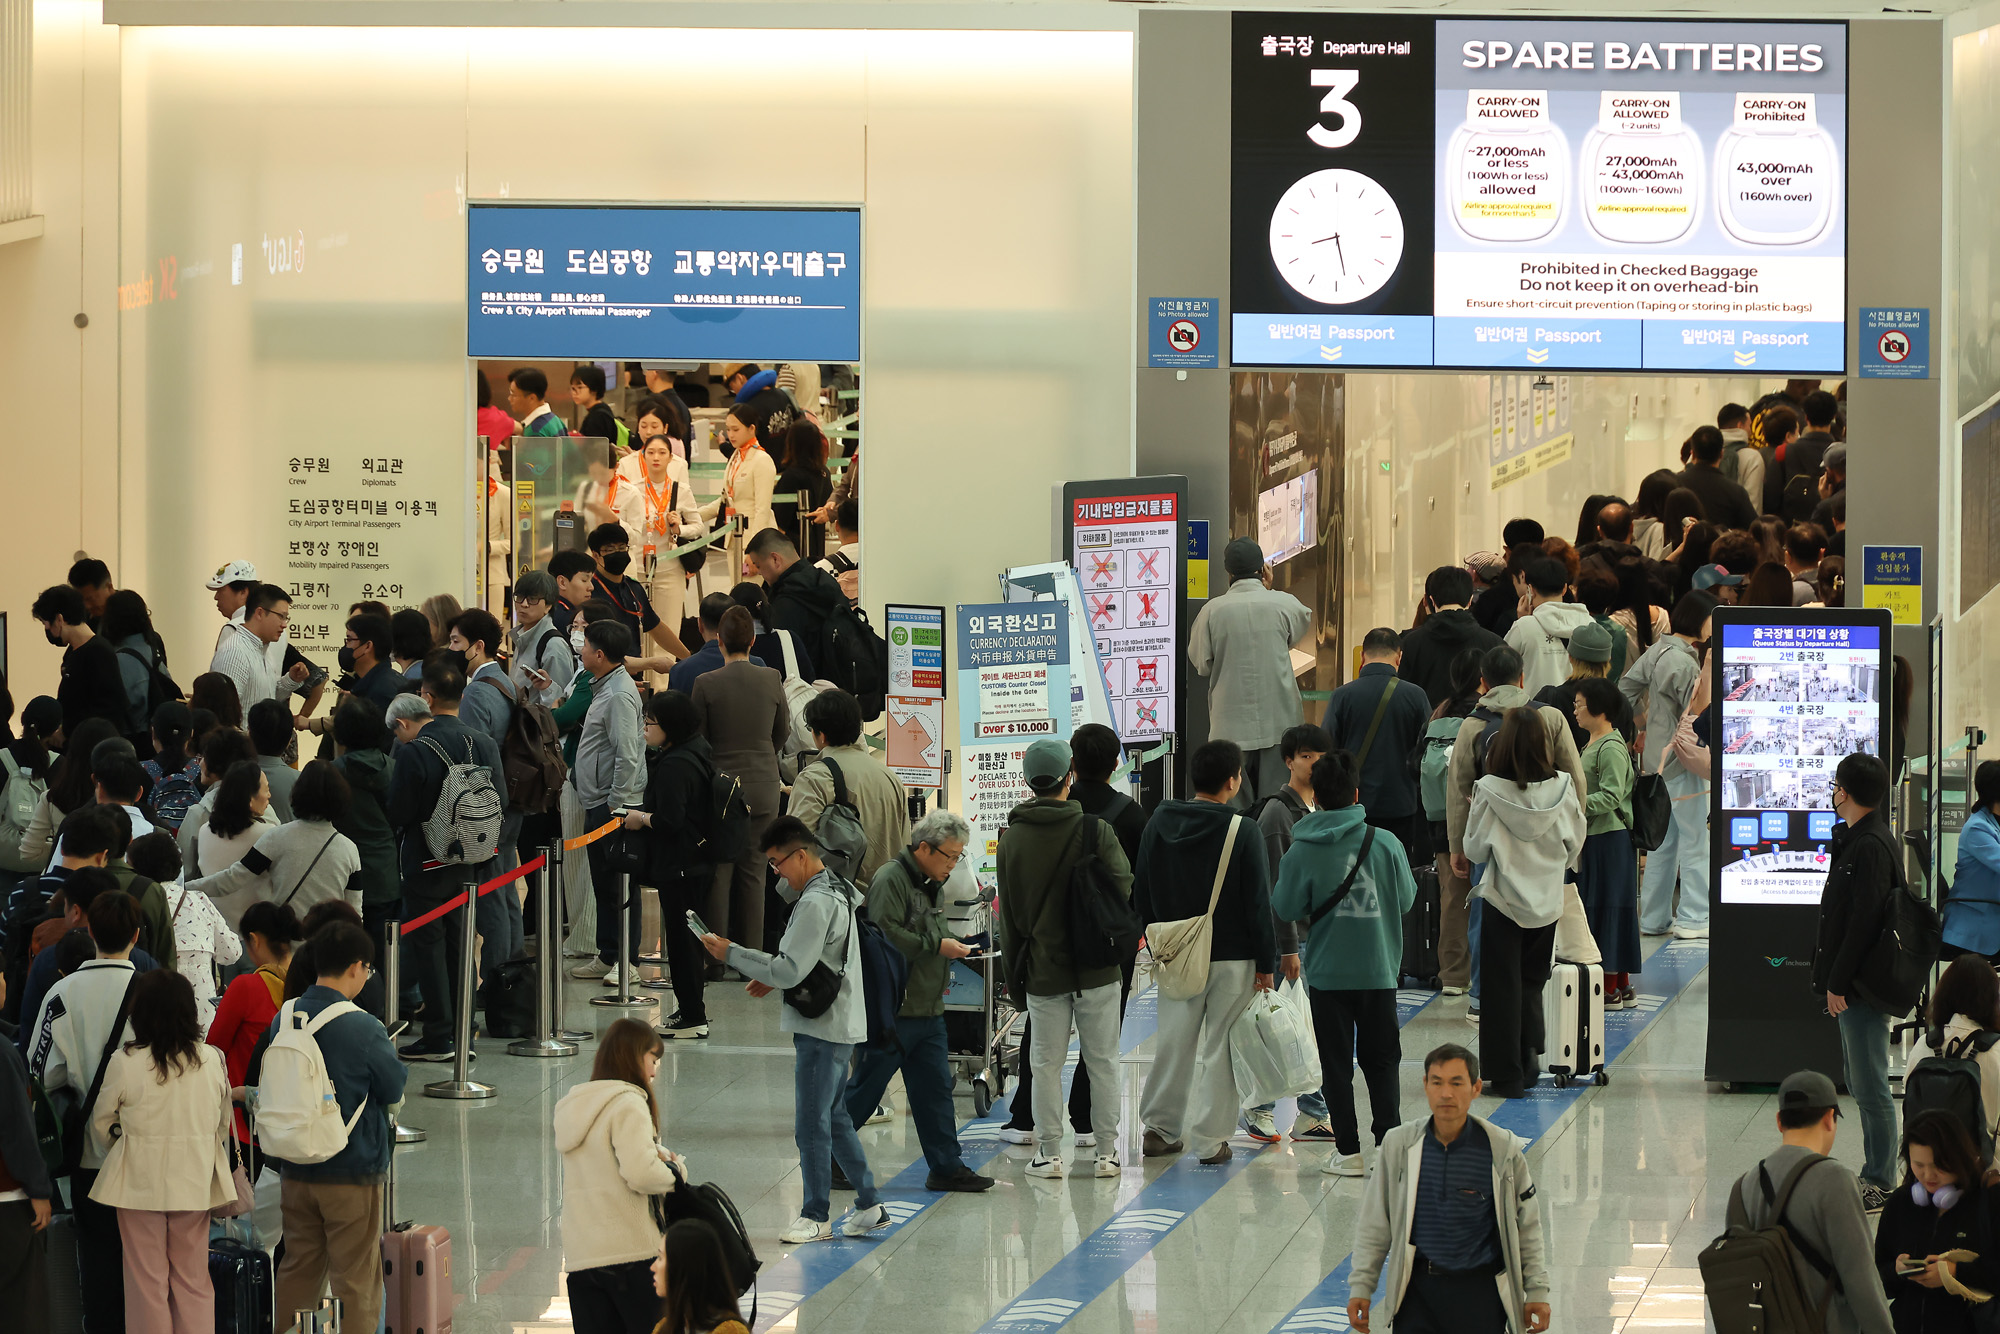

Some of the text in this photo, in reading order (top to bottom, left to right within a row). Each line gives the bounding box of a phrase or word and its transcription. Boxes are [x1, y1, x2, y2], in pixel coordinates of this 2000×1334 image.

[1261, 35, 1314, 56] 출국장
[1324, 41, 1410, 57] Departure Hall
[1462, 40, 1824, 72] SPARE BATTERIES
[1477, 97, 1540, 106] CARRY-ON
[1612, 99, 1670, 108] CARRY-ON
[1744, 100, 1806, 110] CARRY-ON
[1306, 68, 1362, 148] 3
[1478, 109, 1538, 118] ALLOWED
[1614, 110, 1669, 118] ALLOWED
[1745, 112, 1804, 121] Prohibited
[1468, 146, 1546, 158] ~27,000mAh
[1504, 158, 1528, 168] less
[1606, 156, 1676, 168] 27,000mAh
[1737, 163, 1813, 174] 43,000mAh
[1468, 172, 1508, 180] (100Wh
[1525, 172, 1548, 180] less)
[1612, 170, 1684, 181] 43,000mAh
[1761, 177, 1792, 185] over
[1480, 184, 1536, 194] allowed
[1600, 186, 1682, 194] (100Wh~160Wh)
[1740, 192, 1812, 202] (160Wh over)
[482, 248, 846, 277] 승무원 도심공항 교통약자우대출구
[1521, 263, 1758, 279] Prohibited in Checked Baggage
[1520, 278, 1758, 294] Do not keep it on overhead-bin
[1467, 299, 1504, 308] Ensure
[1506, 300, 1572, 308] short-circuit
[1576, 301, 1634, 310] prevention
[1636, 302, 1676, 312] (Taping
[1692, 302, 1730, 312] storing
[1733, 302, 1742, 311] in
[1746, 302, 1780, 312] plastic
[1783, 303, 1812, 313] bags)
[482, 306, 652, 319] Crew & City Airport Terminal Passenger
[1268, 324, 1395, 342] 일반여권 Passport
[1474, 326, 1602, 344] 일반여권 Passport
[1682, 329, 1809, 347] 일반여권 Passport
[289, 458, 330, 472] 승무원
[362, 458, 404, 474] 외교관
[362, 478, 396, 487] Diplomats
[289, 500, 438, 516] 도심공항터미널 이용객
[1078, 500, 1172, 519] 기내반입금지물품
[288, 520, 302, 528] City
[304, 520, 328, 528] Airport
[362, 521, 401, 530] Passengers
[289, 540, 378, 557] 보행상 장애인
[288, 562, 390, 572] Mobility Impaired Passengers
[1876, 564, 1910, 573] 진입불가
[289, 582, 330, 598] 고령자
[362, 583, 404, 598] 유소아
[969, 613, 1056, 634] 외국환신고
[289, 624, 330, 639] 임신부
[1753, 628, 1849, 640] 출국장별 대기열 상황
[970, 635, 1057, 650] CURRENCY DECLARATION
[971, 649, 1057, 664] 外币申报 外貨申告
[1780, 652, 1824, 662] 2번 출국장
[1002, 671, 1031, 680] 세관신고대
[1778, 705, 1824, 715] 4번 출국장
[983, 722, 1048, 734] over $ 10,000
[1778, 759, 1824, 769] 5번 출국장
[979, 772, 1006, 781] DECLARE
